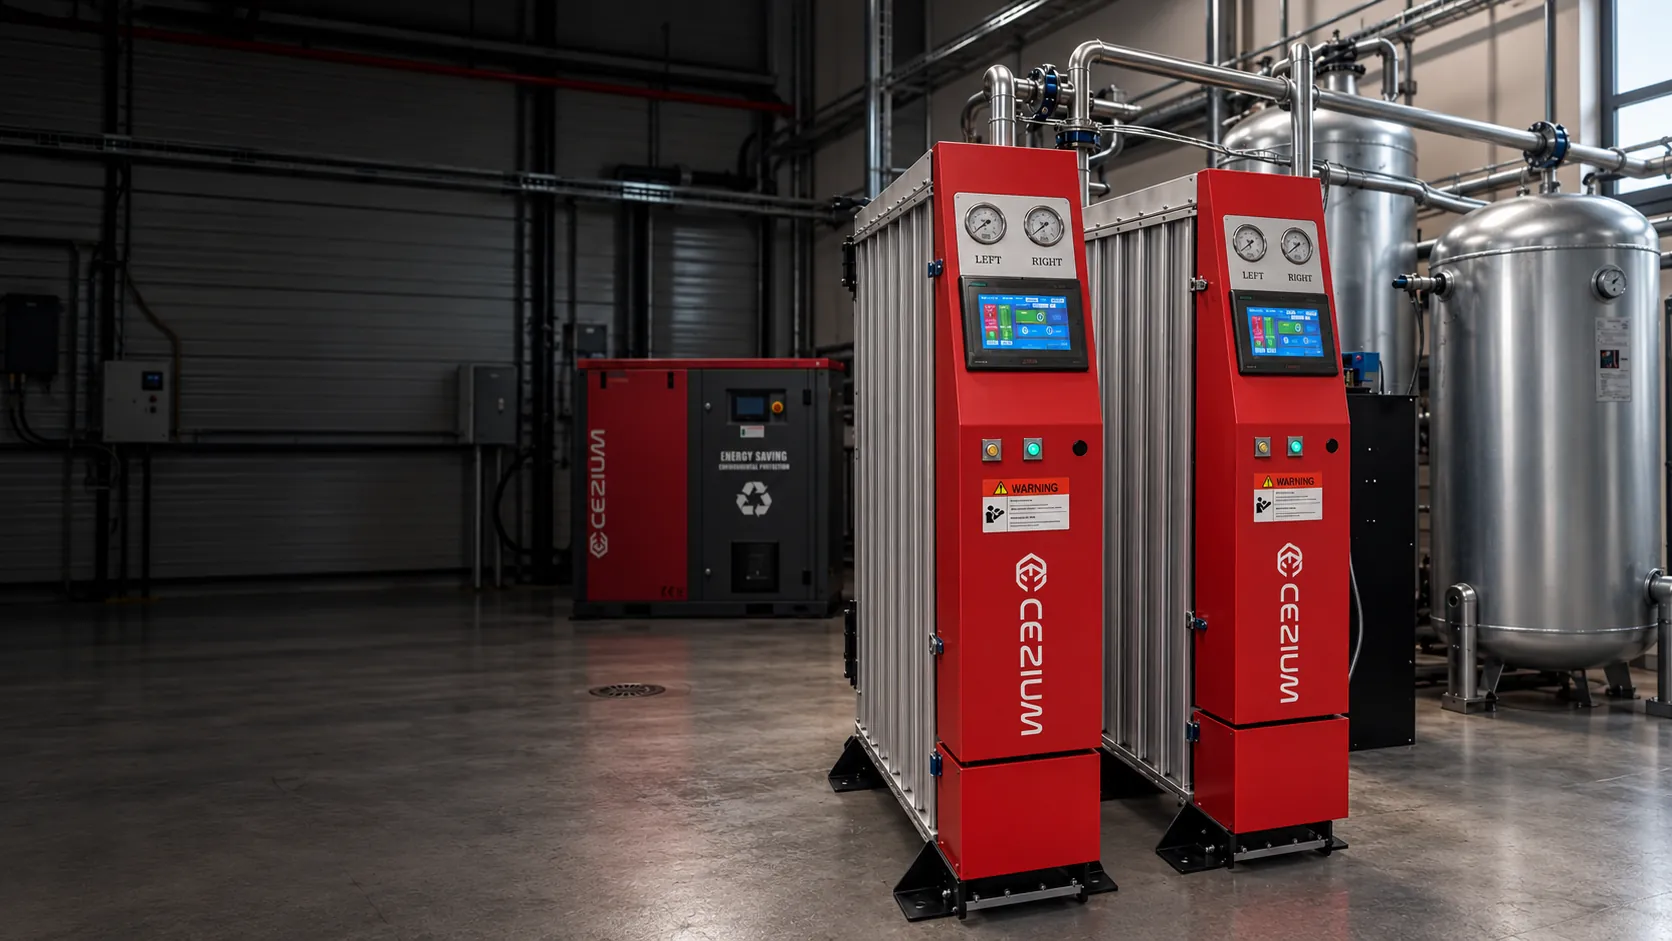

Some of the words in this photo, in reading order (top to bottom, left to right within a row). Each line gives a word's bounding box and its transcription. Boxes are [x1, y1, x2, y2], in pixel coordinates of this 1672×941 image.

[975, 255, 1002, 265] LEFT
[1032, 257, 1063, 267] RIGHT
[1242, 271, 1265, 280] LEFT
[1288, 273, 1313, 283] RIGHT
[720, 451, 753, 461] ENERGY
[755, 451, 788, 461] SAVING
[590, 429, 606, 529] CEZIUM
[1276, 476, 1315, 487] WARNING
[1011, 482, 1059, 494] WARNING
[1280, 582, 1299, 704] CEZIUM
[1020, 597, 1043, 737] CEZIUM
